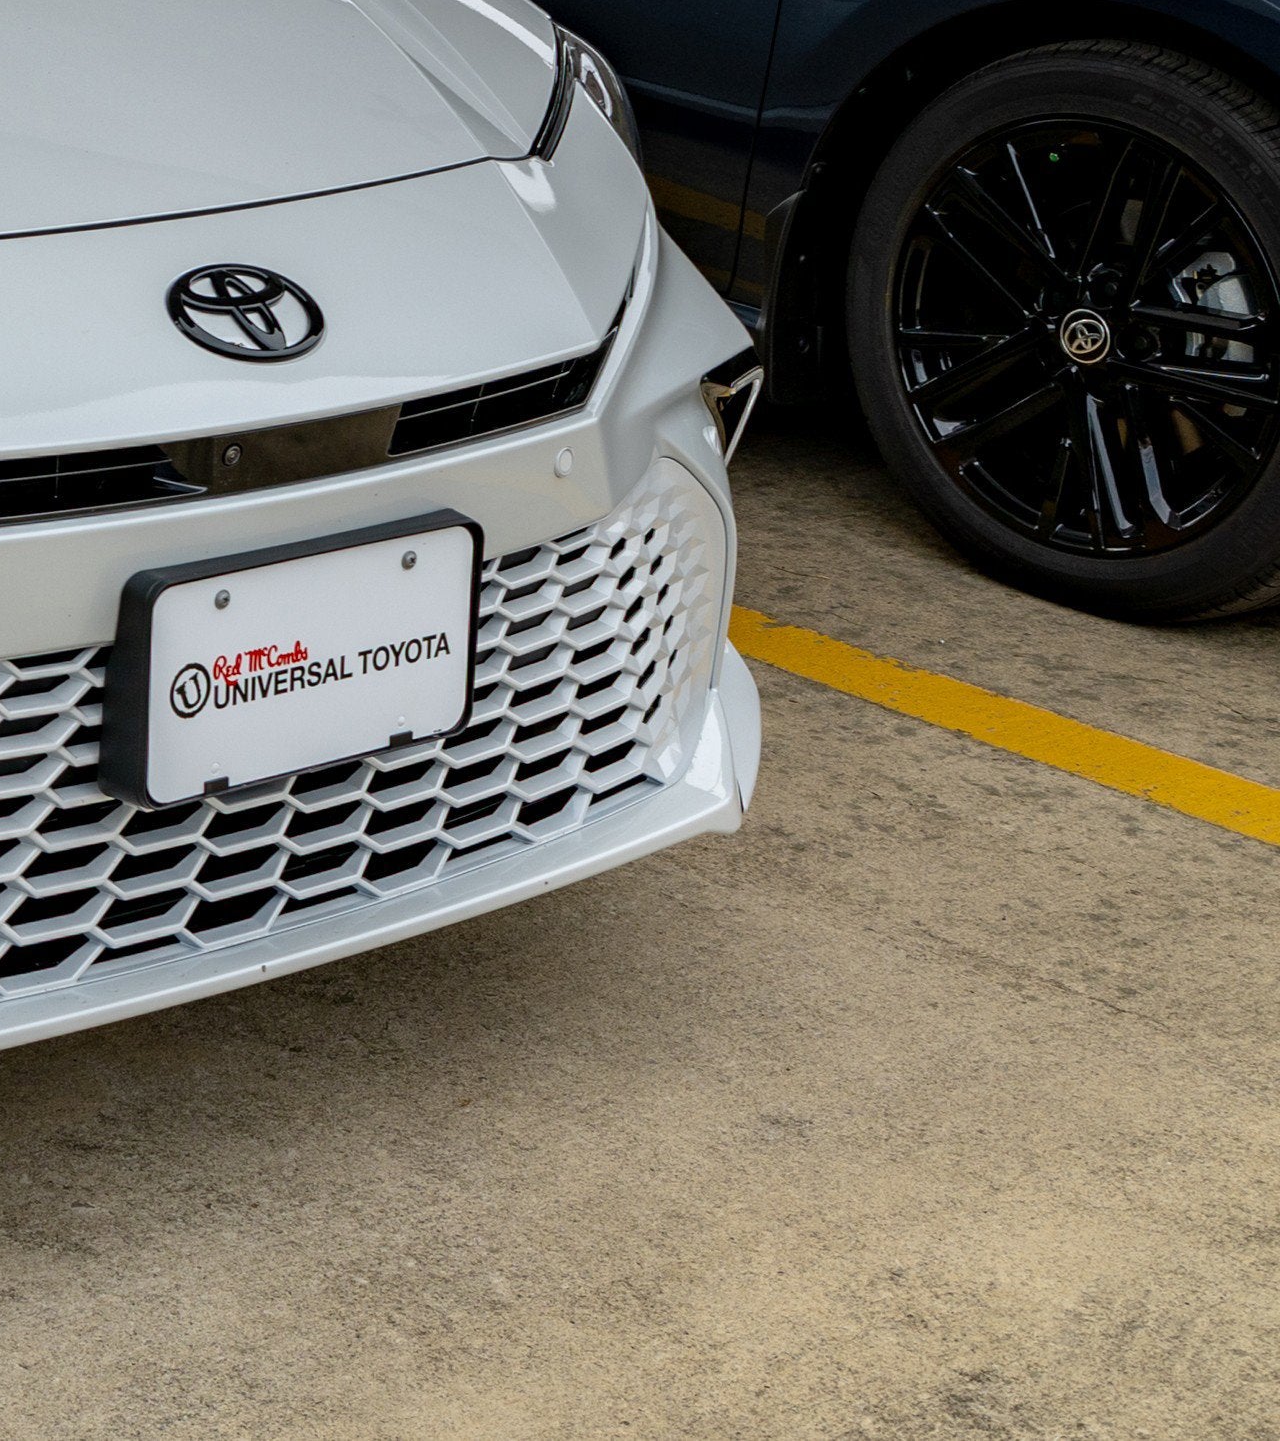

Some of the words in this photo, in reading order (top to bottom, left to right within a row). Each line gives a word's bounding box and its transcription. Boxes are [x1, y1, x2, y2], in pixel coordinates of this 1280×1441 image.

[213, 653, 243, 687] Red
[244, 640, 308, 673] McCombs
[214, 655, 353, 710] UNIVERSAL
[358, 632, 451, 675] TOYOTA
